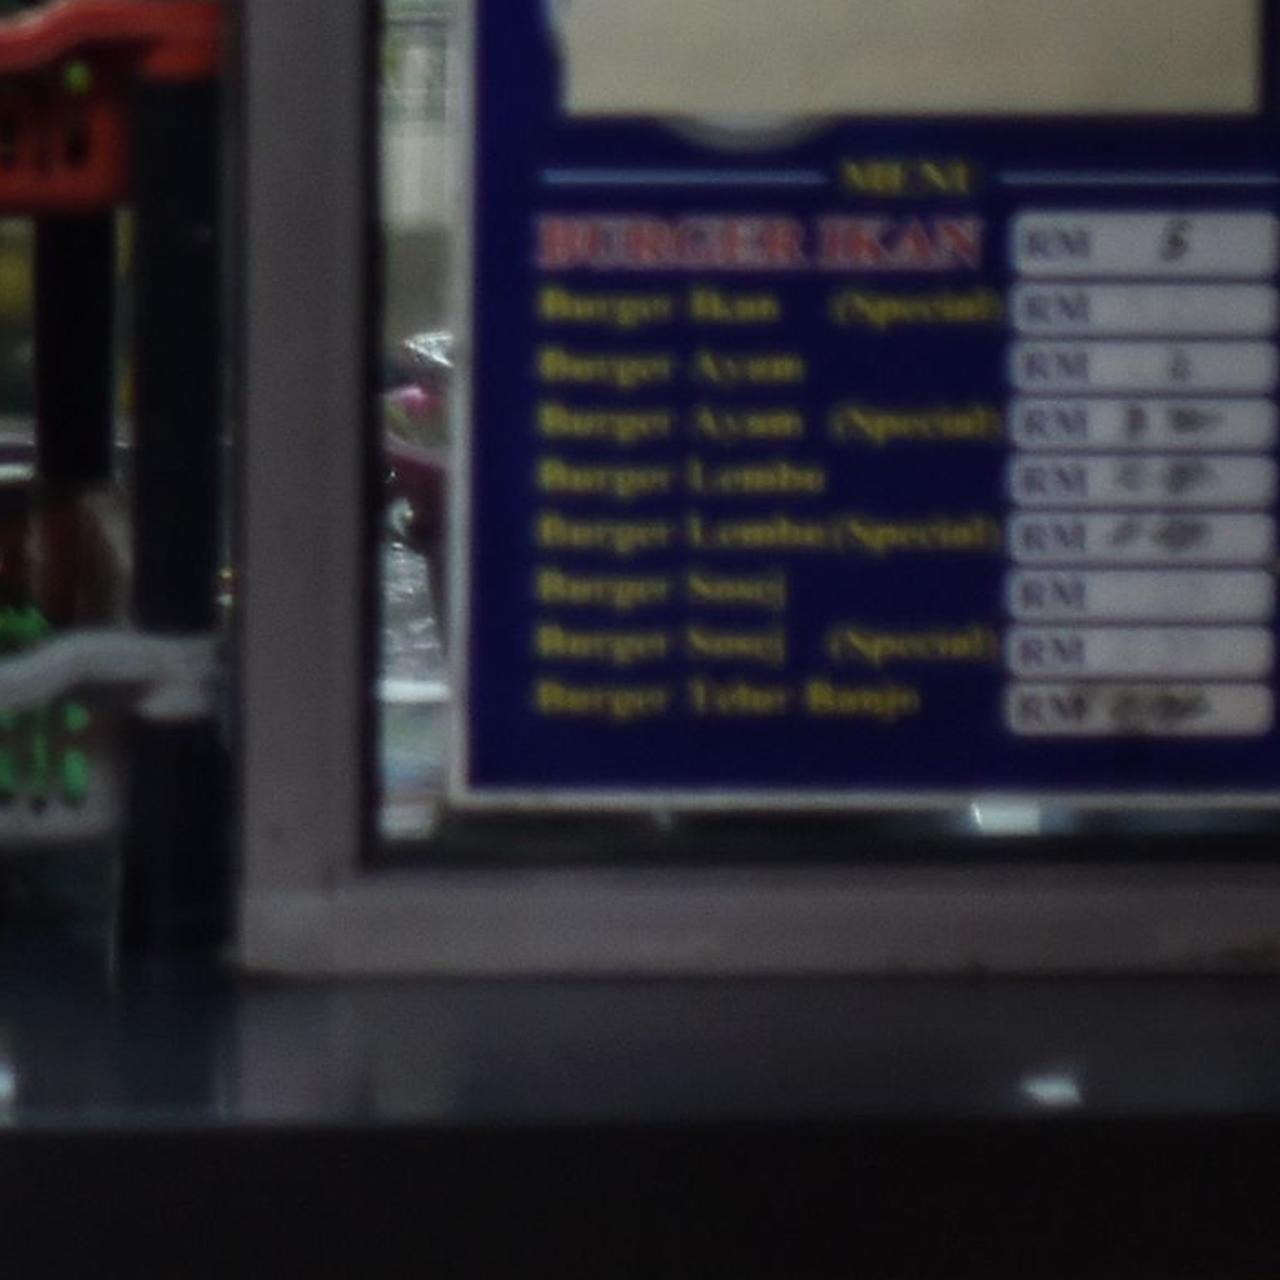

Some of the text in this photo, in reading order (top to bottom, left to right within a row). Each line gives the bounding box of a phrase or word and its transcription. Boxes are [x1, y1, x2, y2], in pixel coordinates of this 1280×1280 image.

[536, 213, 804, 270] BURGER
[819, 214, 981, 270] IKAN
[539, 286, 672, 328] Burger
[538, 346, 672, 389] Burger
[538, 401, 672, 444] Burger
[537, 457, 672, 500] Burger
[537, 511, 672, 554] Burger
[537, 567, 670, 610] Burger
[536, 623, 670, 666] Burger
[535, 679, 669, 722] Burger
